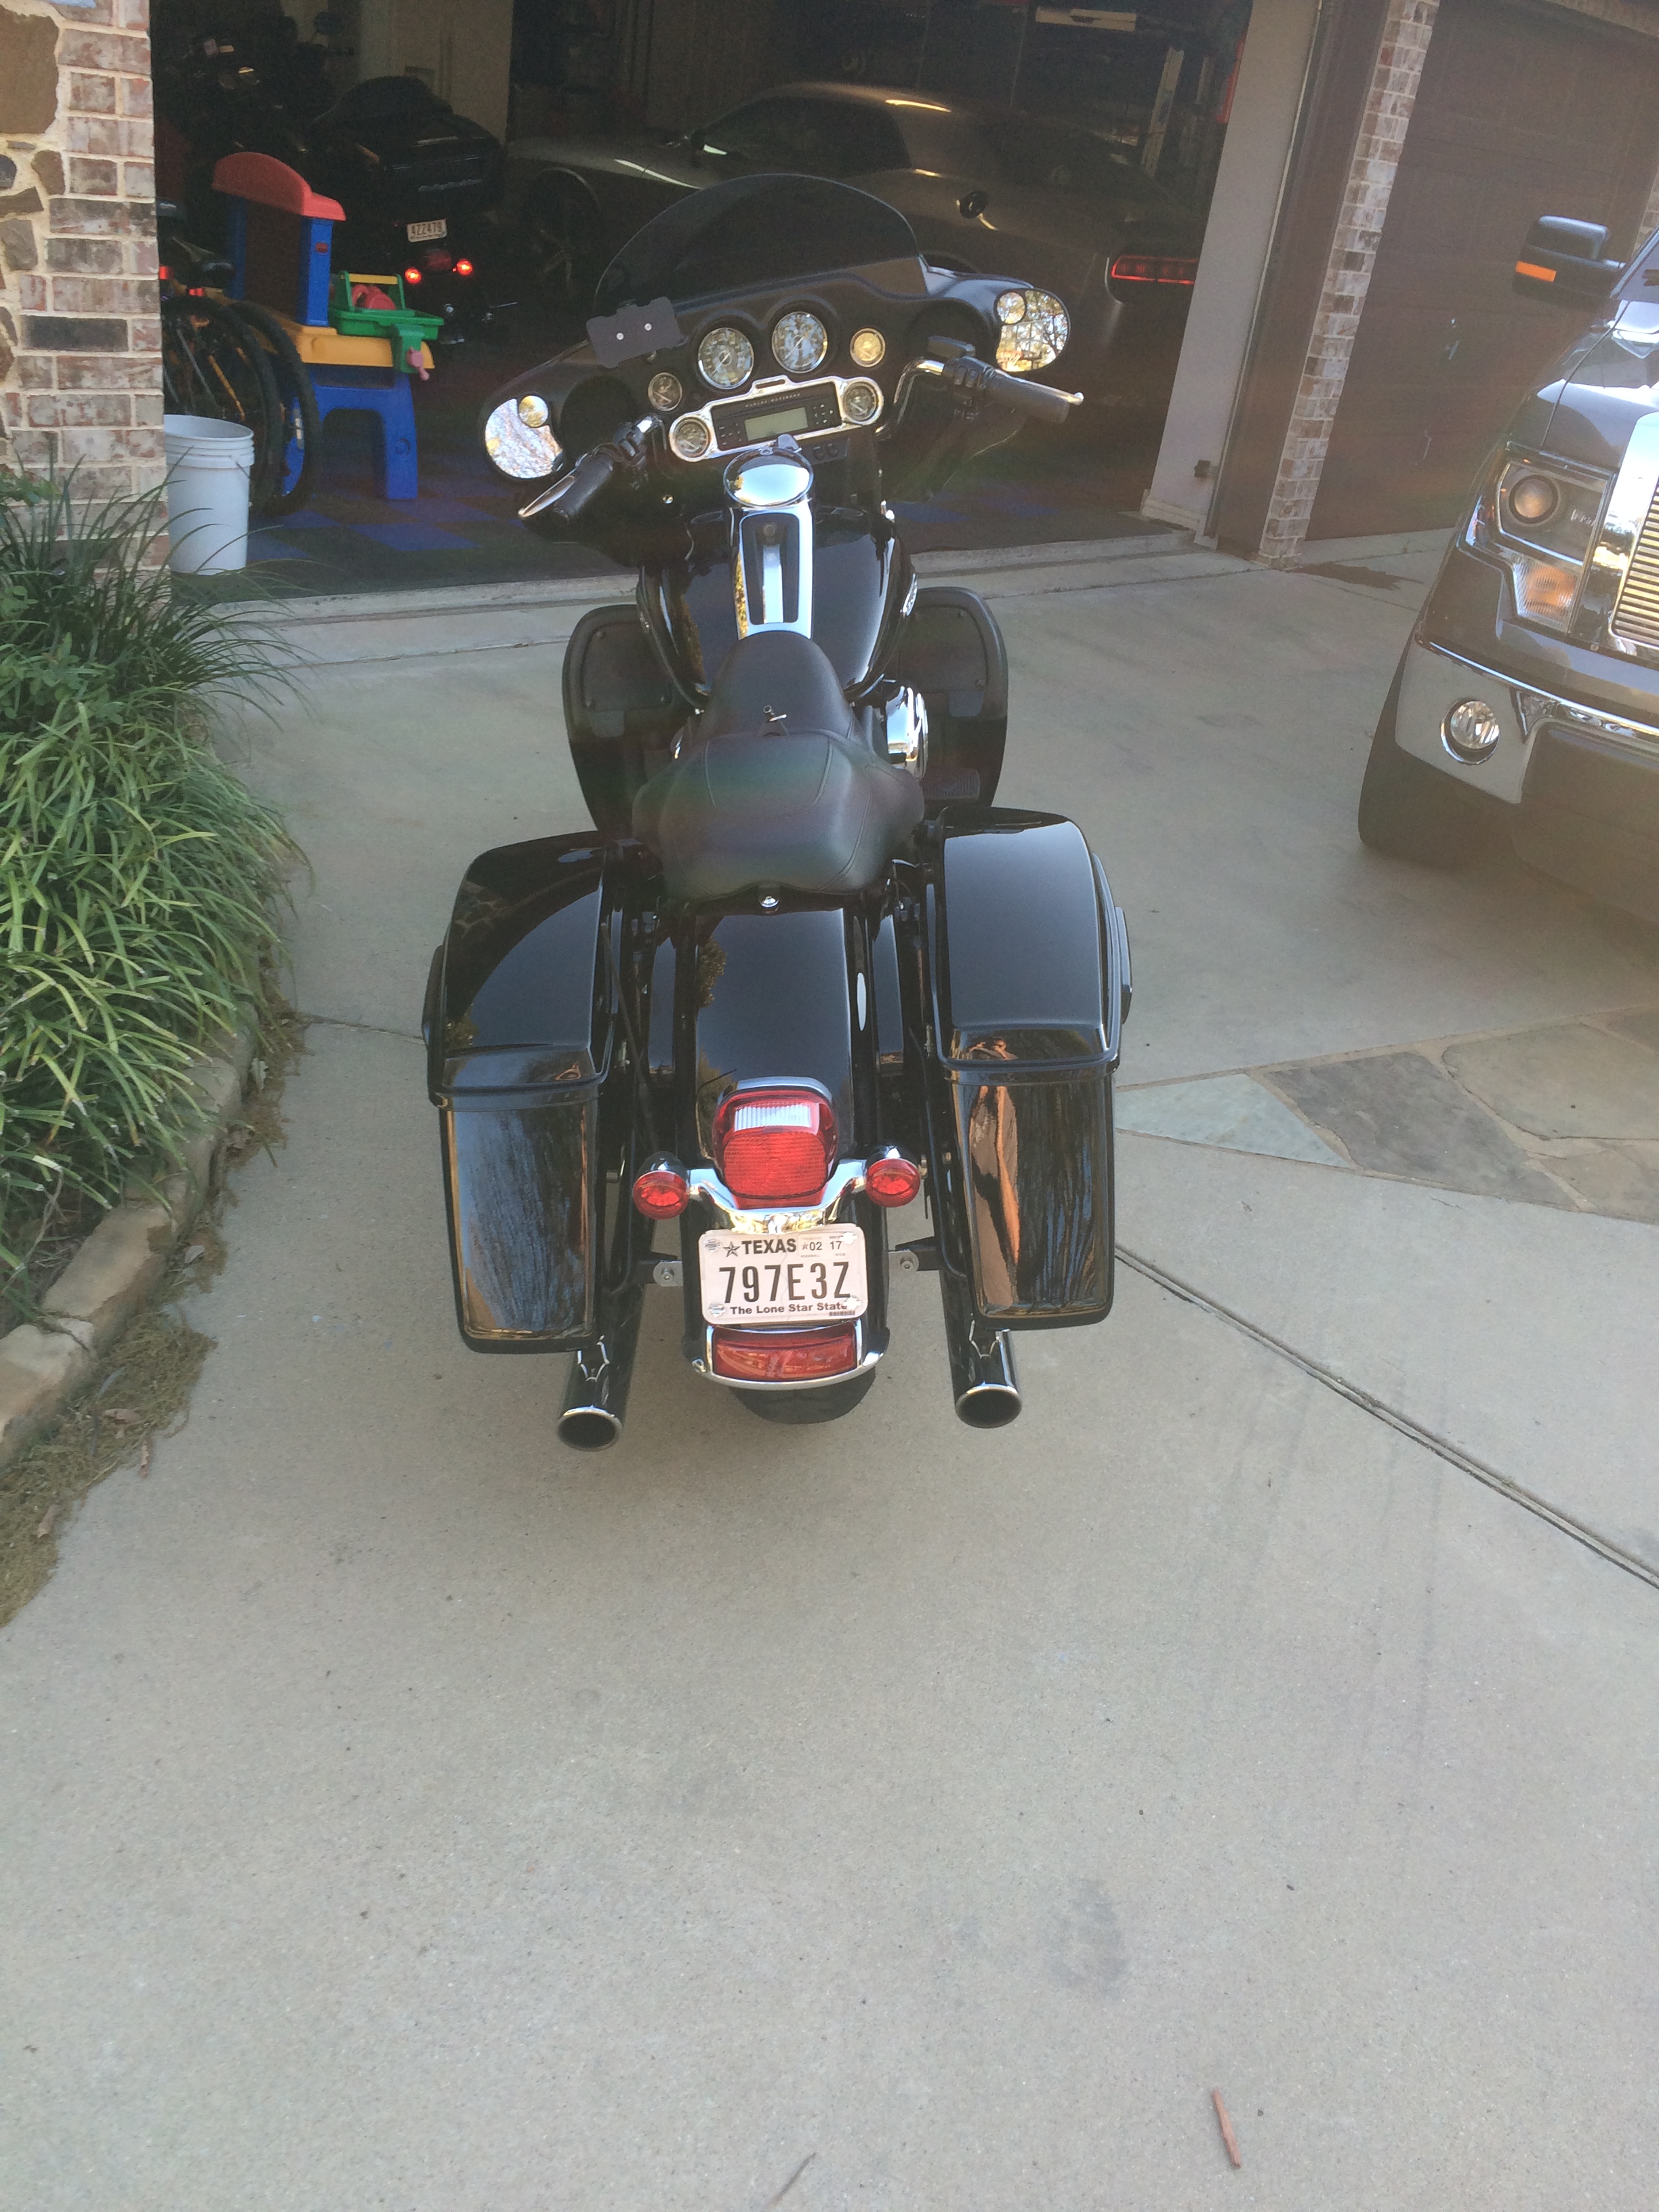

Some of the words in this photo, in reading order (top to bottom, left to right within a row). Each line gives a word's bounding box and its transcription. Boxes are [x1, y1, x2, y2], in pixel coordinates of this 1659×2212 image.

[742, 1238, 796, 1254] TEXAS
[810, 1241, 823, 1251] 02
[830, 1240, 842, 1250] 17
[719, 1261, 851, 1304] 797E3Z
[730, 1305, 752, 1315] The
[756, 1304, 784, 1313] Lone
[788, 1303, 812, 1313] Star
